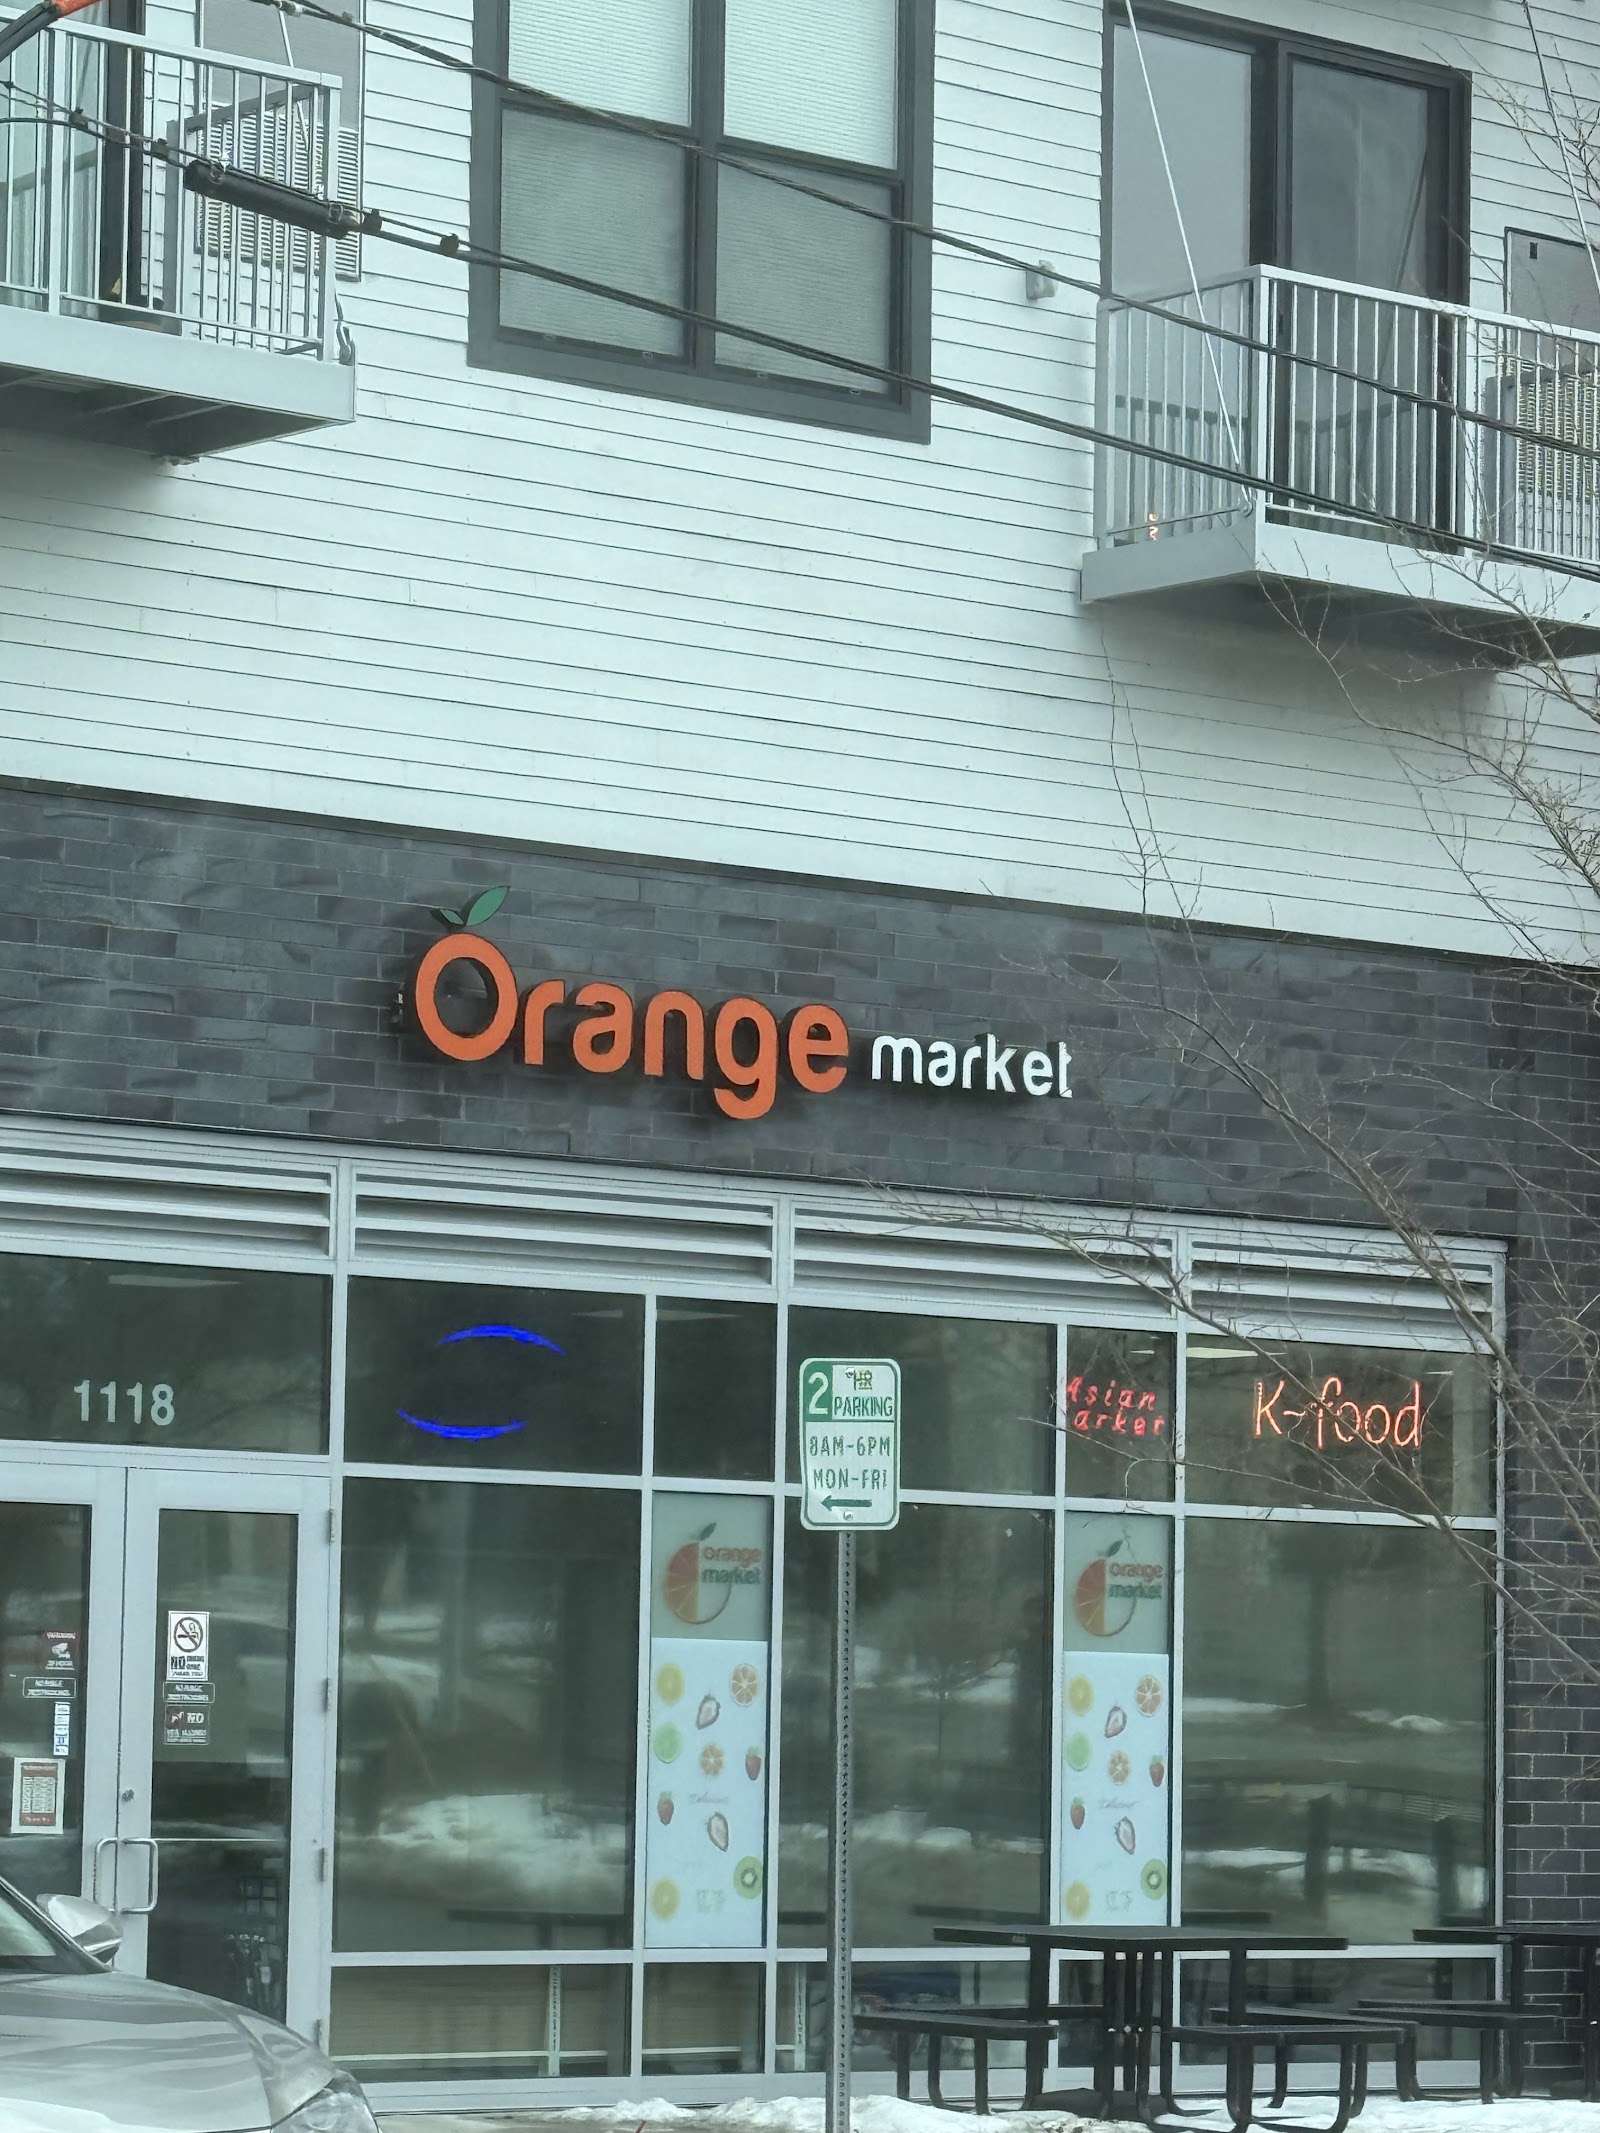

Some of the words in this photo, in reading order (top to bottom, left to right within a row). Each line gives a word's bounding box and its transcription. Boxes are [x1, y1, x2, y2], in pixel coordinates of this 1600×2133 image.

[416, 933, 849, 1120] Orange
[871, 1033, 1073, 1099] market
[73, 1379, 175, 1426] 1118
[808, 1371, 829, 1415] 2
[834, 1396, 893, 1417] PARKING
[1254, 1376, 1421, 1450] K-food
[809, 1435, 890, 1456] 8AM-6PM
[813, 1469, 887, 1490] MON-FRI
[702, 1567, 761, 1585] market
